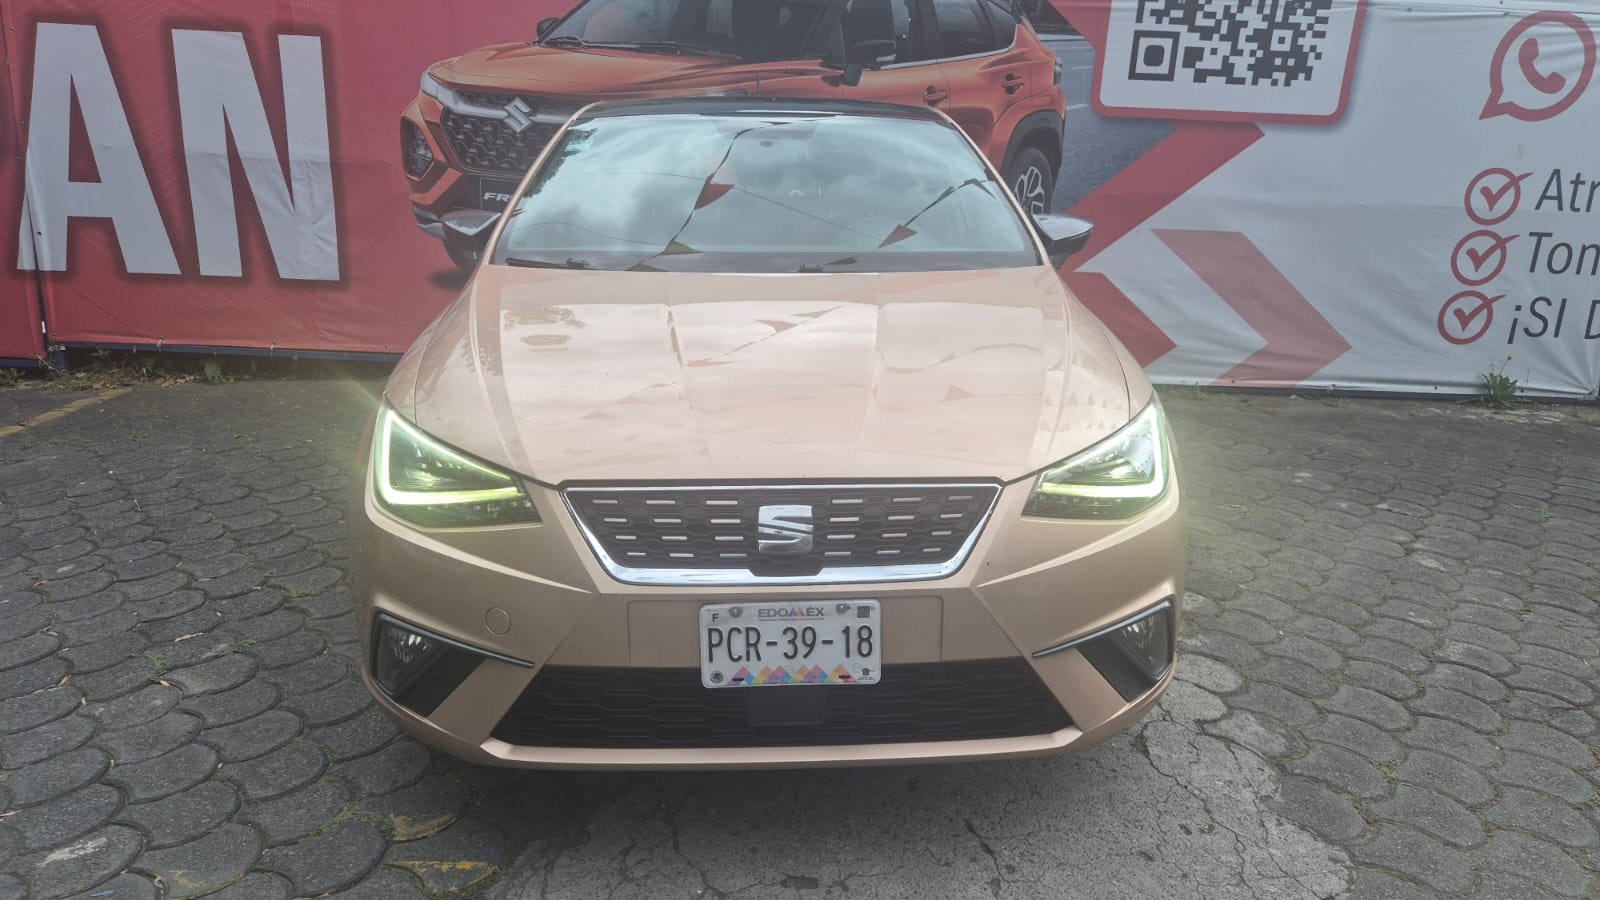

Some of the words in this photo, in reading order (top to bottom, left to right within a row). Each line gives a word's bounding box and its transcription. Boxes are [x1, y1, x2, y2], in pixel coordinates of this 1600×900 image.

[17, 22, 340, 281] AN
[483, 192, 513, 202] FR
[707, 624, 873, 663] PCR-39-18
